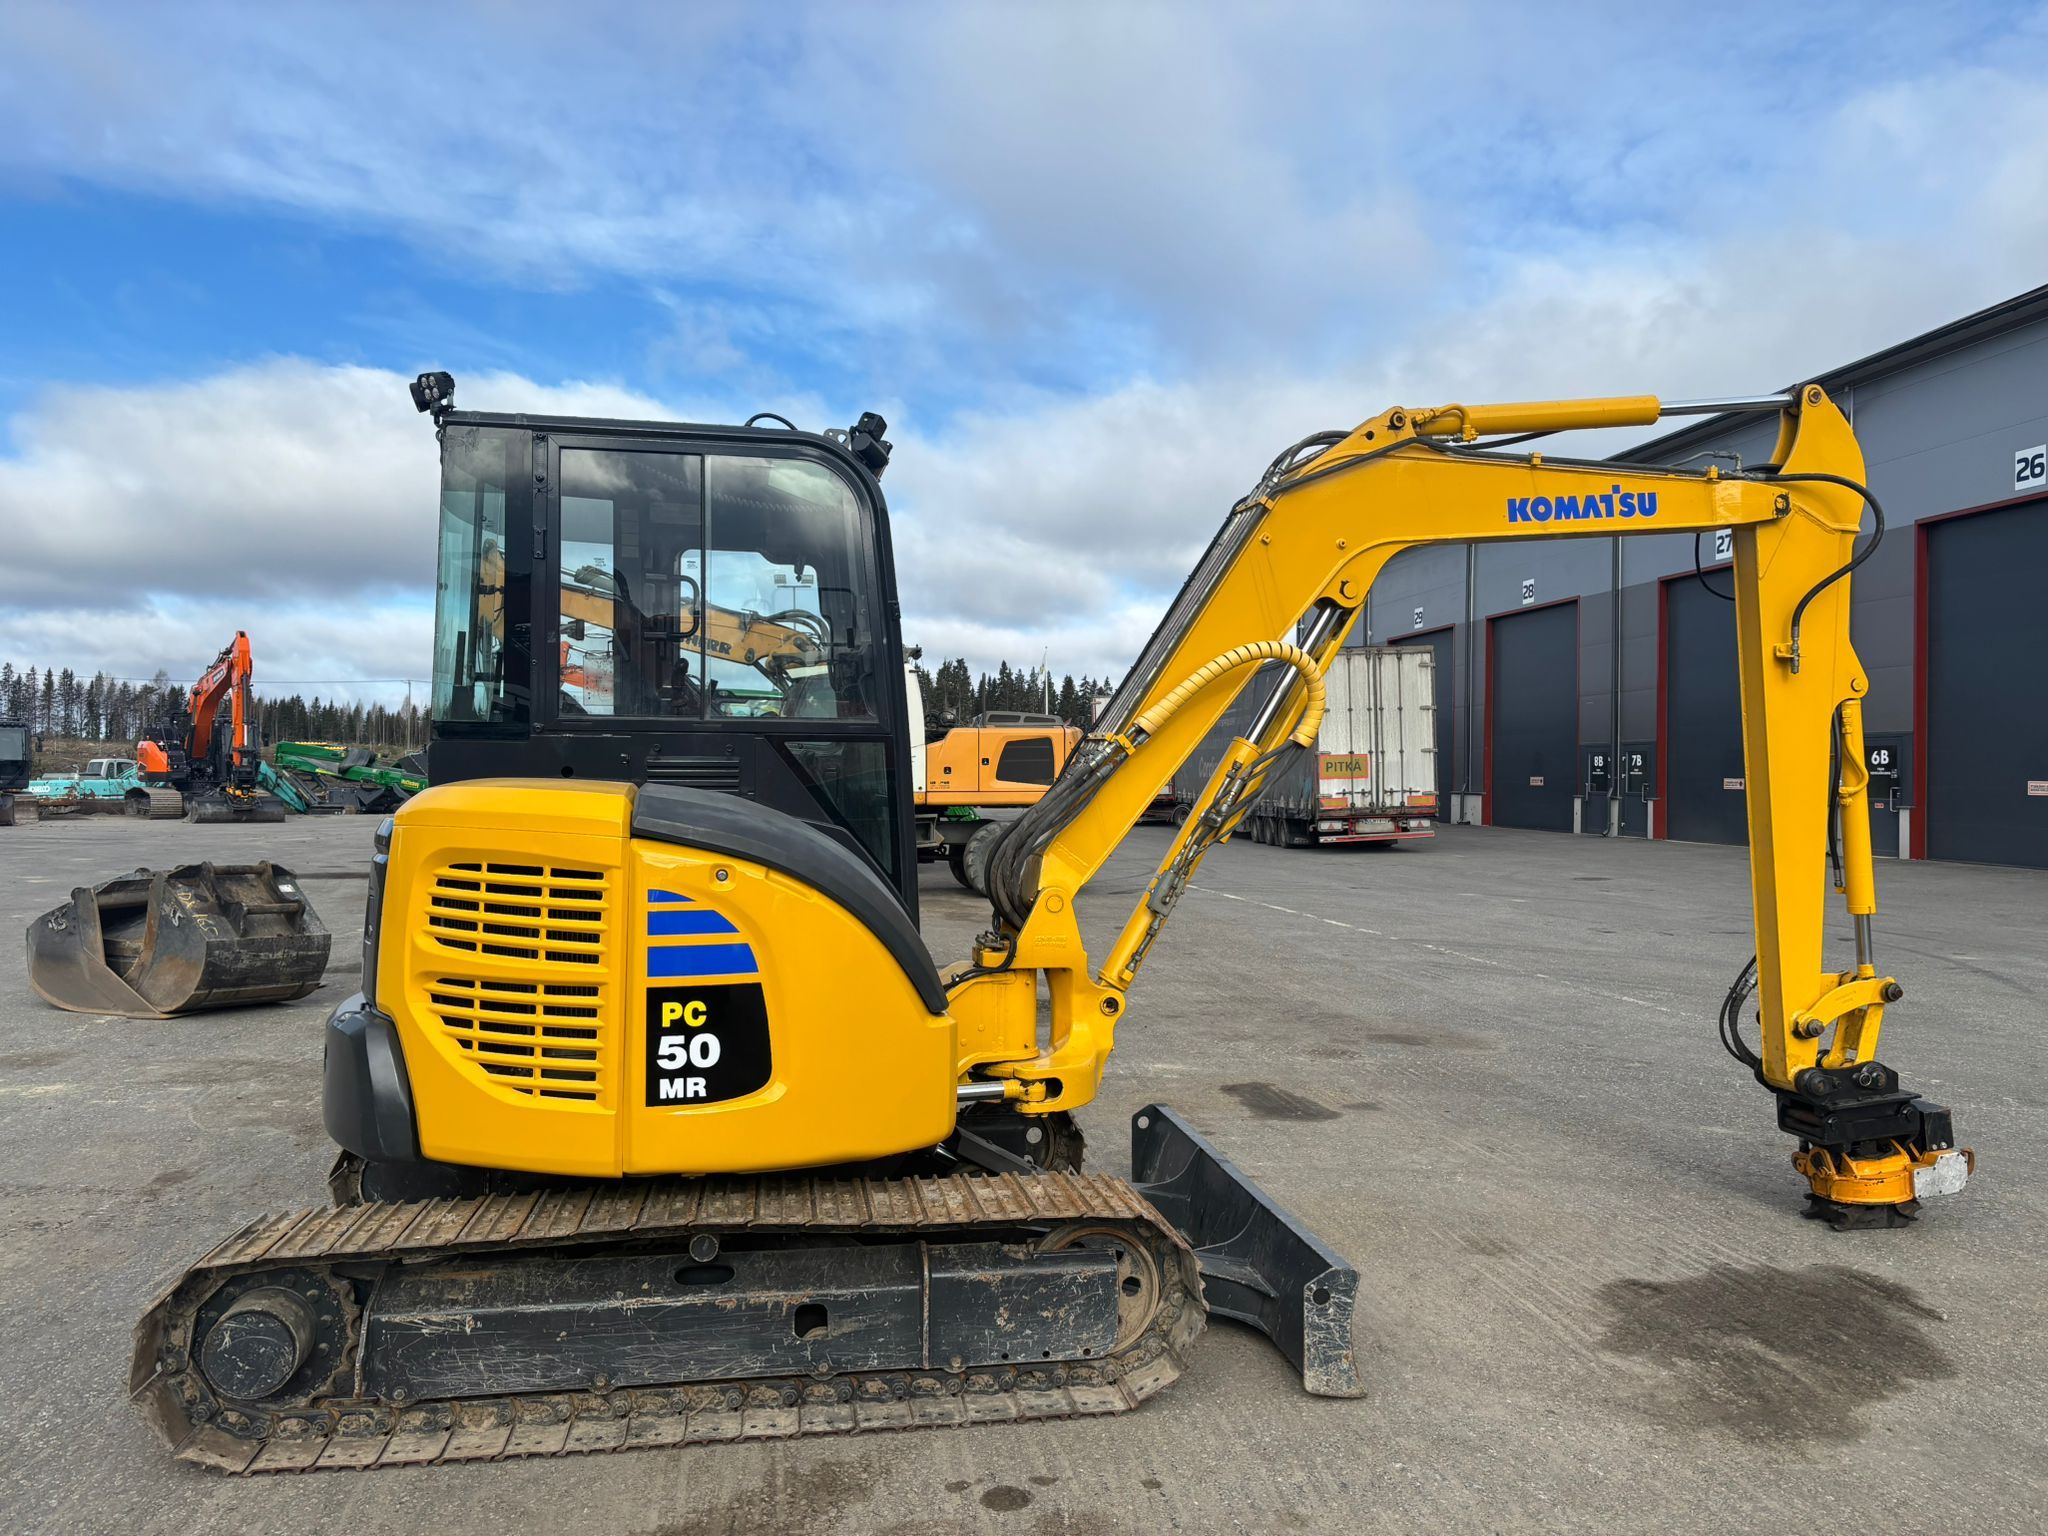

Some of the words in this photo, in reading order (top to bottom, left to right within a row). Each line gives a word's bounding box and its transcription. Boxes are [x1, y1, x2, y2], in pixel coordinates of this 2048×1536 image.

[2016, 453, 2045, 482] 26
[1507, 485, 1658, 523] KOMATSU
[1716, 533, 1732, 554] 27
[1523, 584, 1534, 599] 28
[1415, 611, 1423, 625] 29
[1325, 759, 1362, 773] PITKÄ
[1594, 755, 1604, 767] 8B
[1631, 754, 1642, 766] 7B
[1871, 749, 1890, 765] 6B
[662, 1000, 707, 1028] PC
[656, 1033, 721, 1070] 50
[659, 1077, 707, 1099] MR
